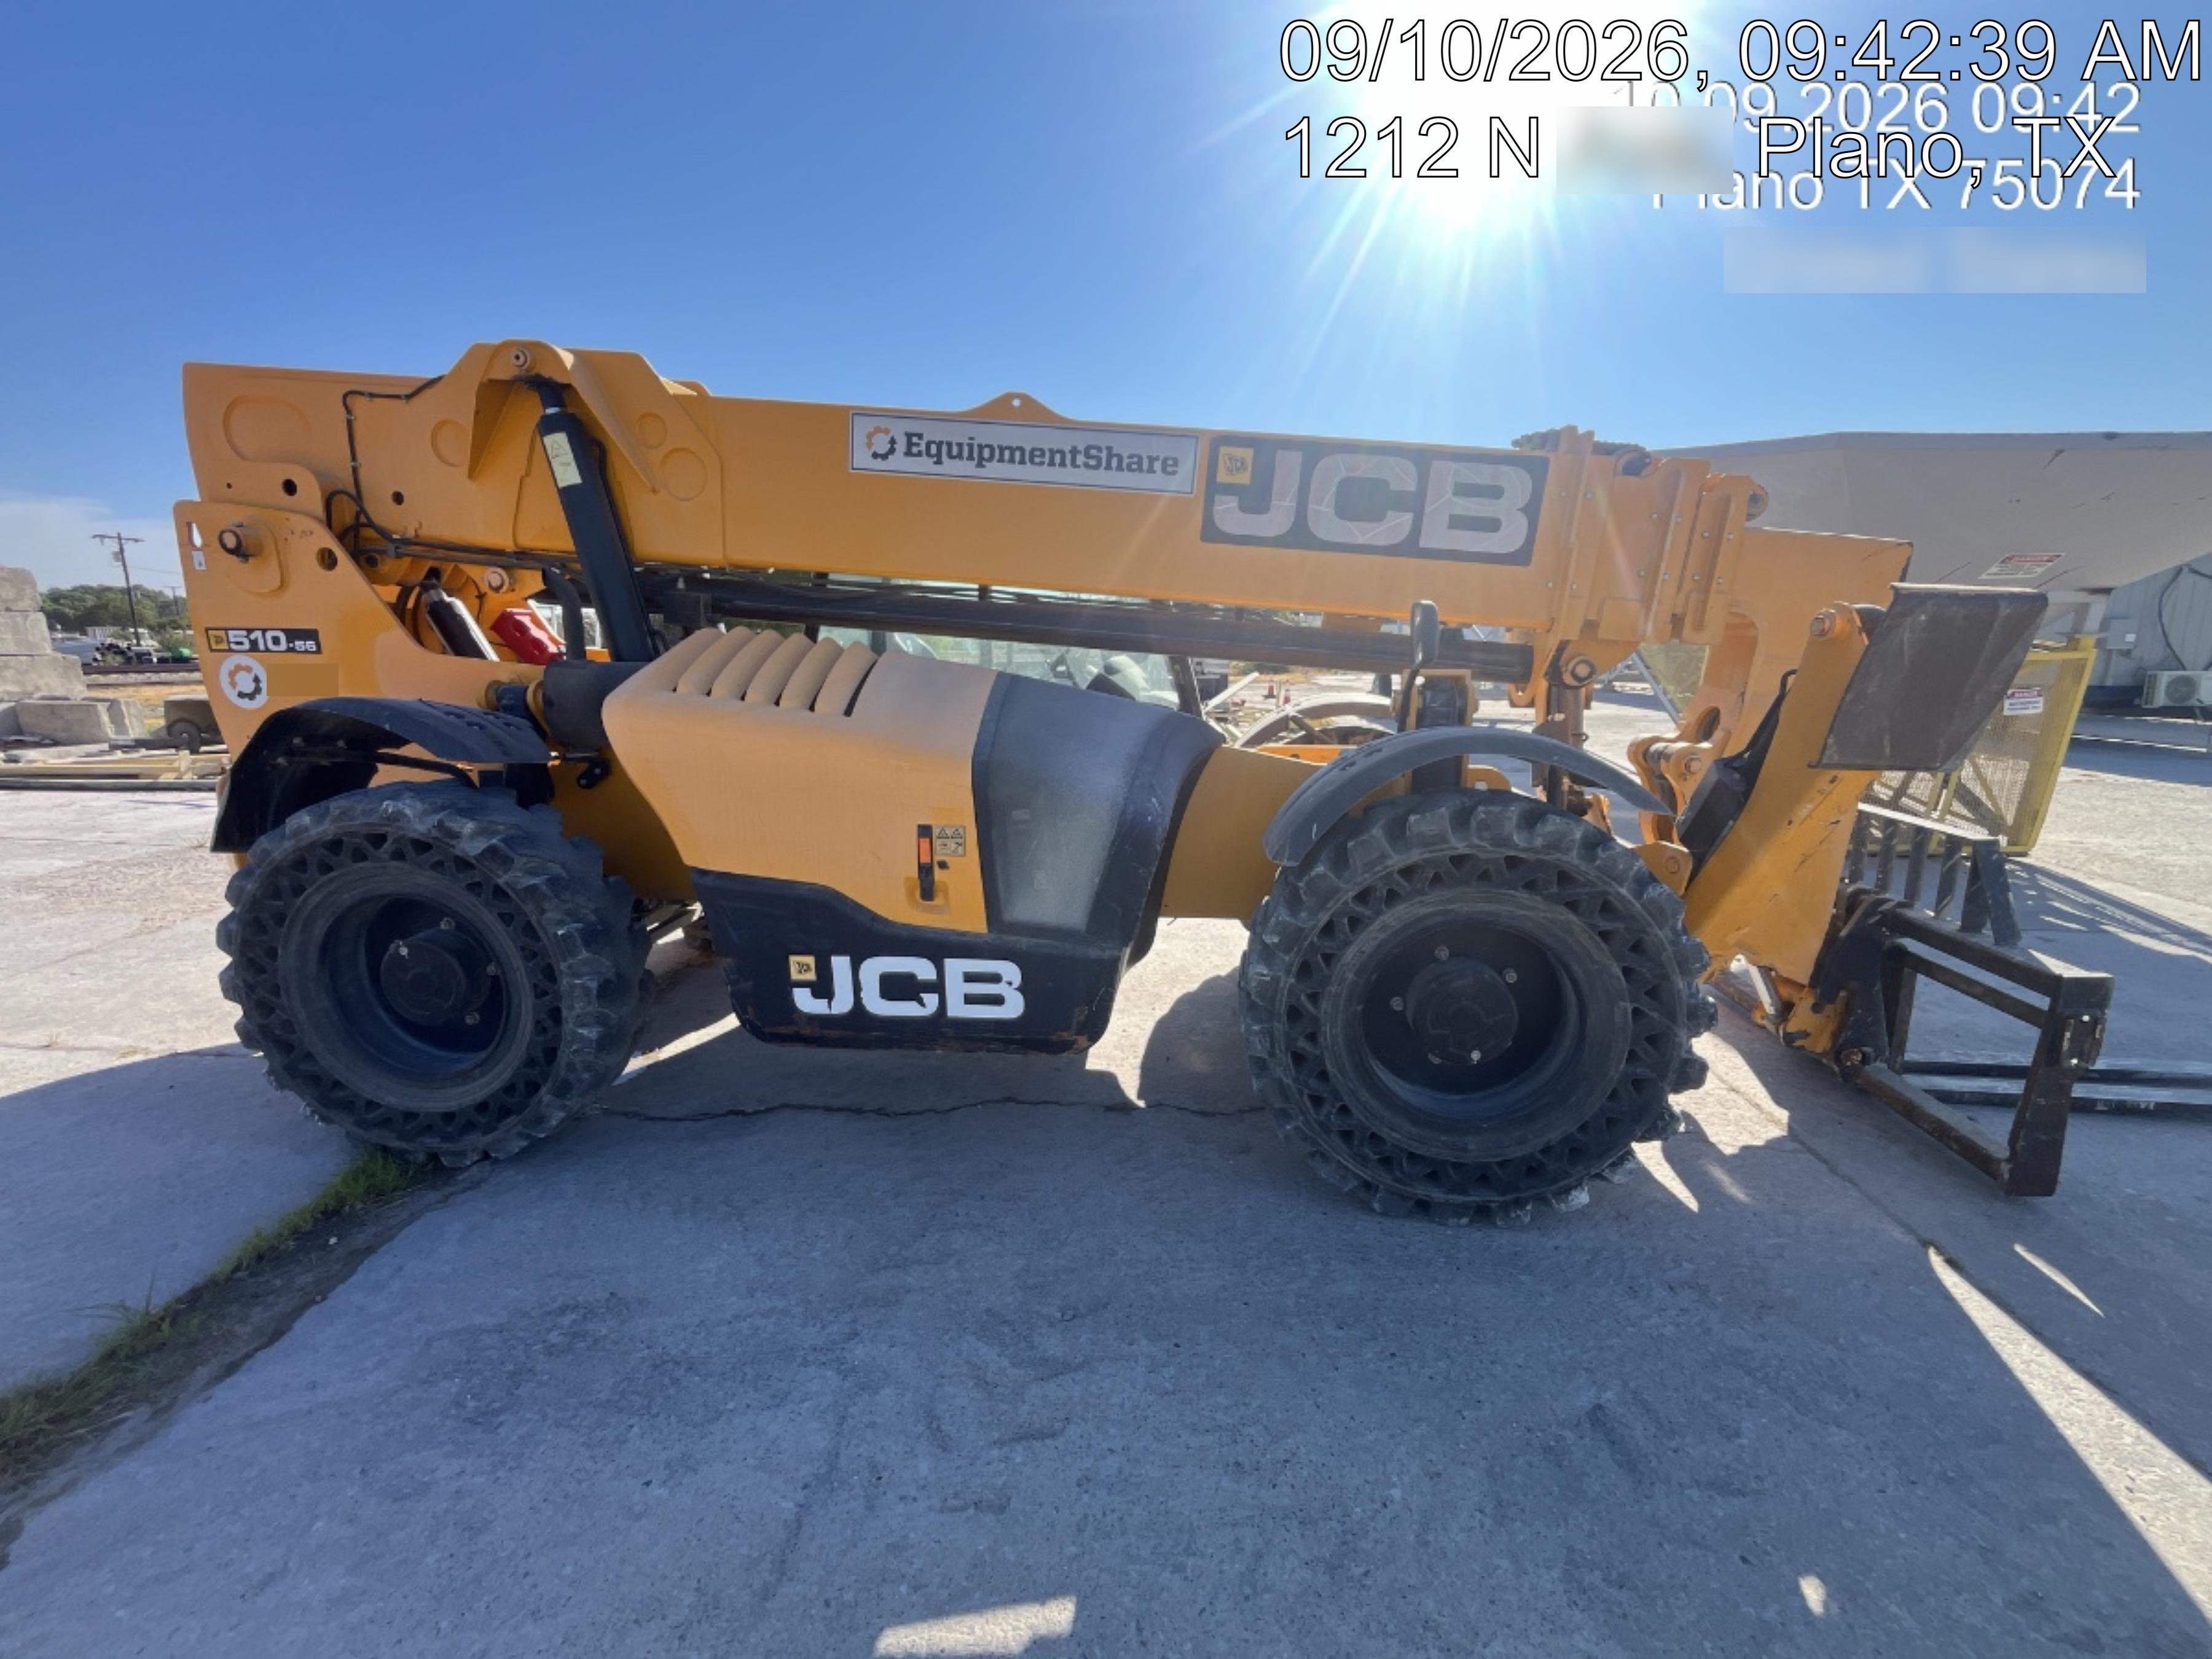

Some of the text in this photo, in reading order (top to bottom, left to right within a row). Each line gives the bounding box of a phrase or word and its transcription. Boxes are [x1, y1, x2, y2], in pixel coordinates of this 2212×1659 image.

[903, 431, 1179, 476] EquipmentShare
[1212, 449, 1533, 554] JCB
[792, 955, 1026, 1019] JCB
